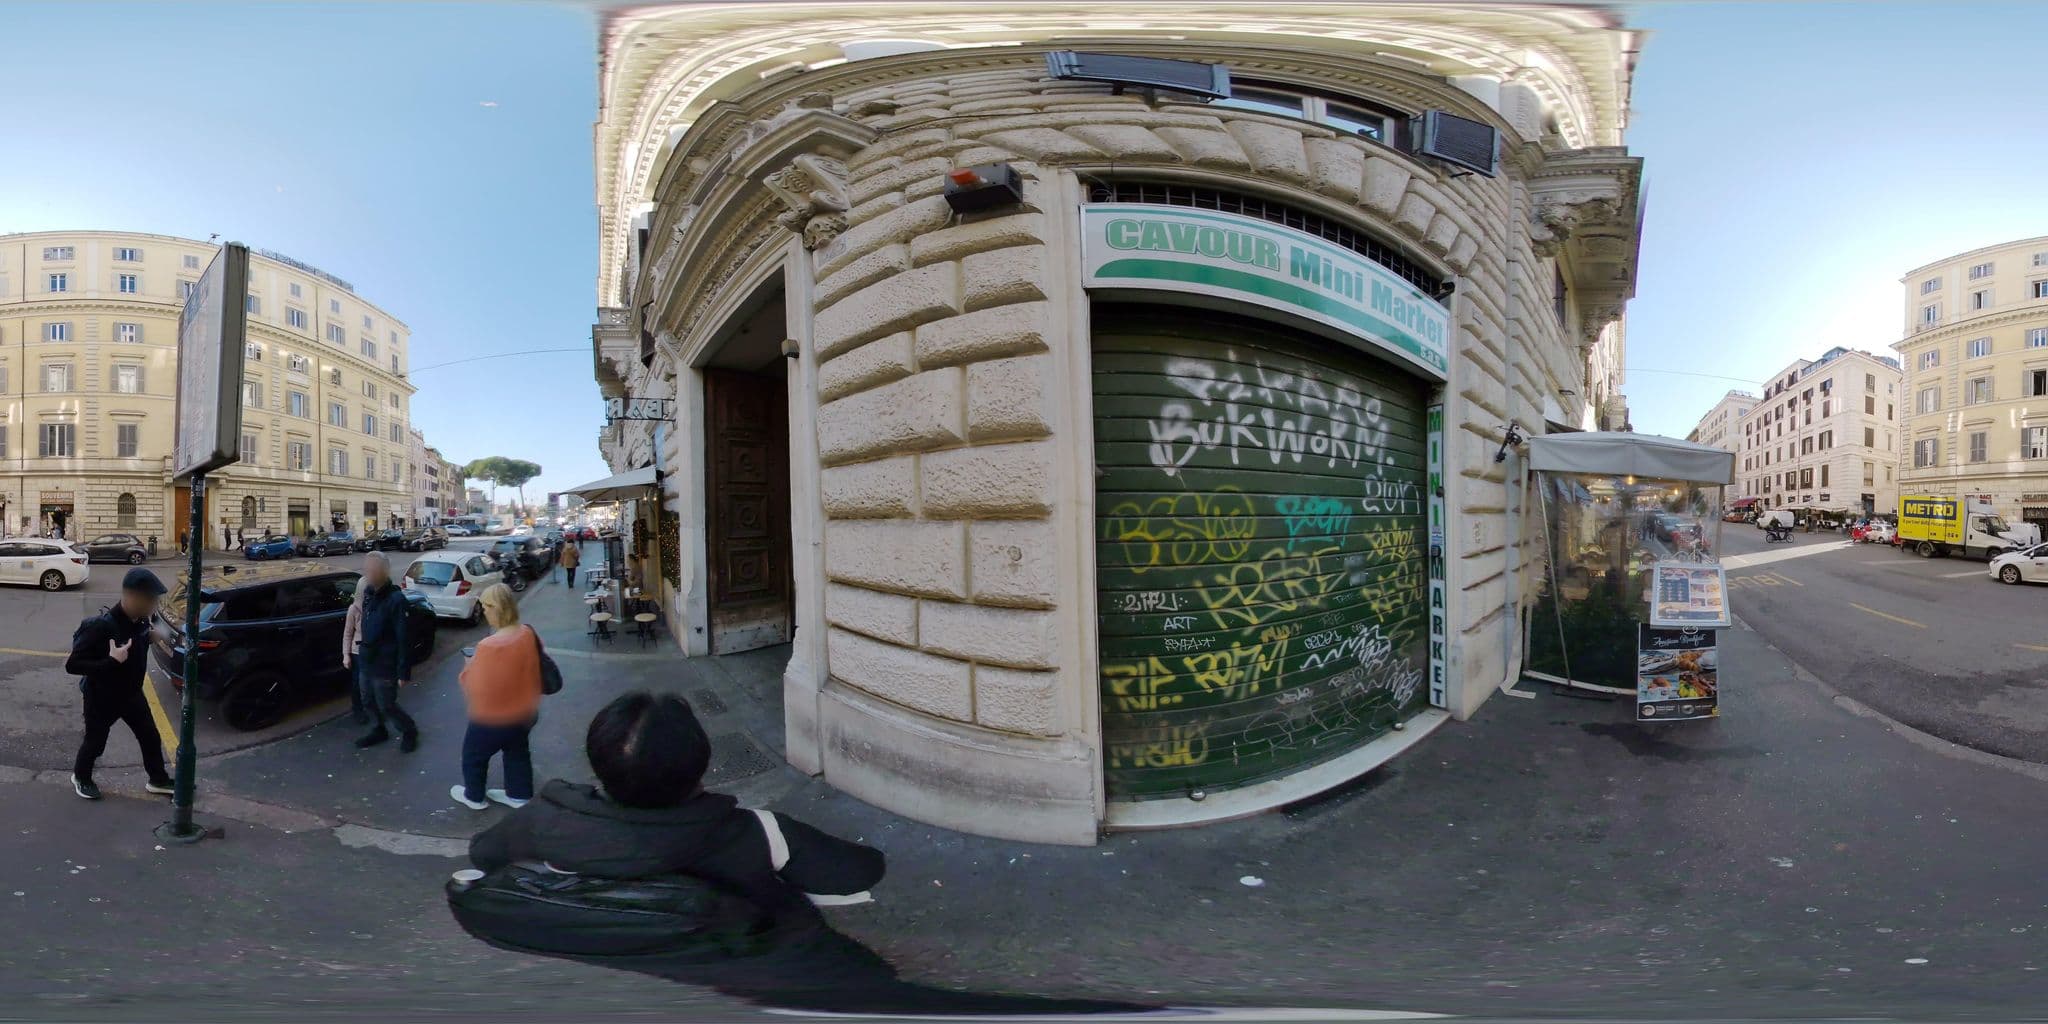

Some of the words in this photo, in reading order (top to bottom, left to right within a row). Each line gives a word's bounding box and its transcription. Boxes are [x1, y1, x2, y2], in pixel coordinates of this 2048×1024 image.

[1106, 218, 1281, 271] CAVOUR
[1290, 245, 1363, 304] Mini
[1371, 279, 1443, 347] Market
[1428, 410, 1442, 527] MINI
[1906, 502, 1954, 517] METRO
[1164, 616, 1198, 631] ART
[1430, 557, 1444, 705] MARKET
